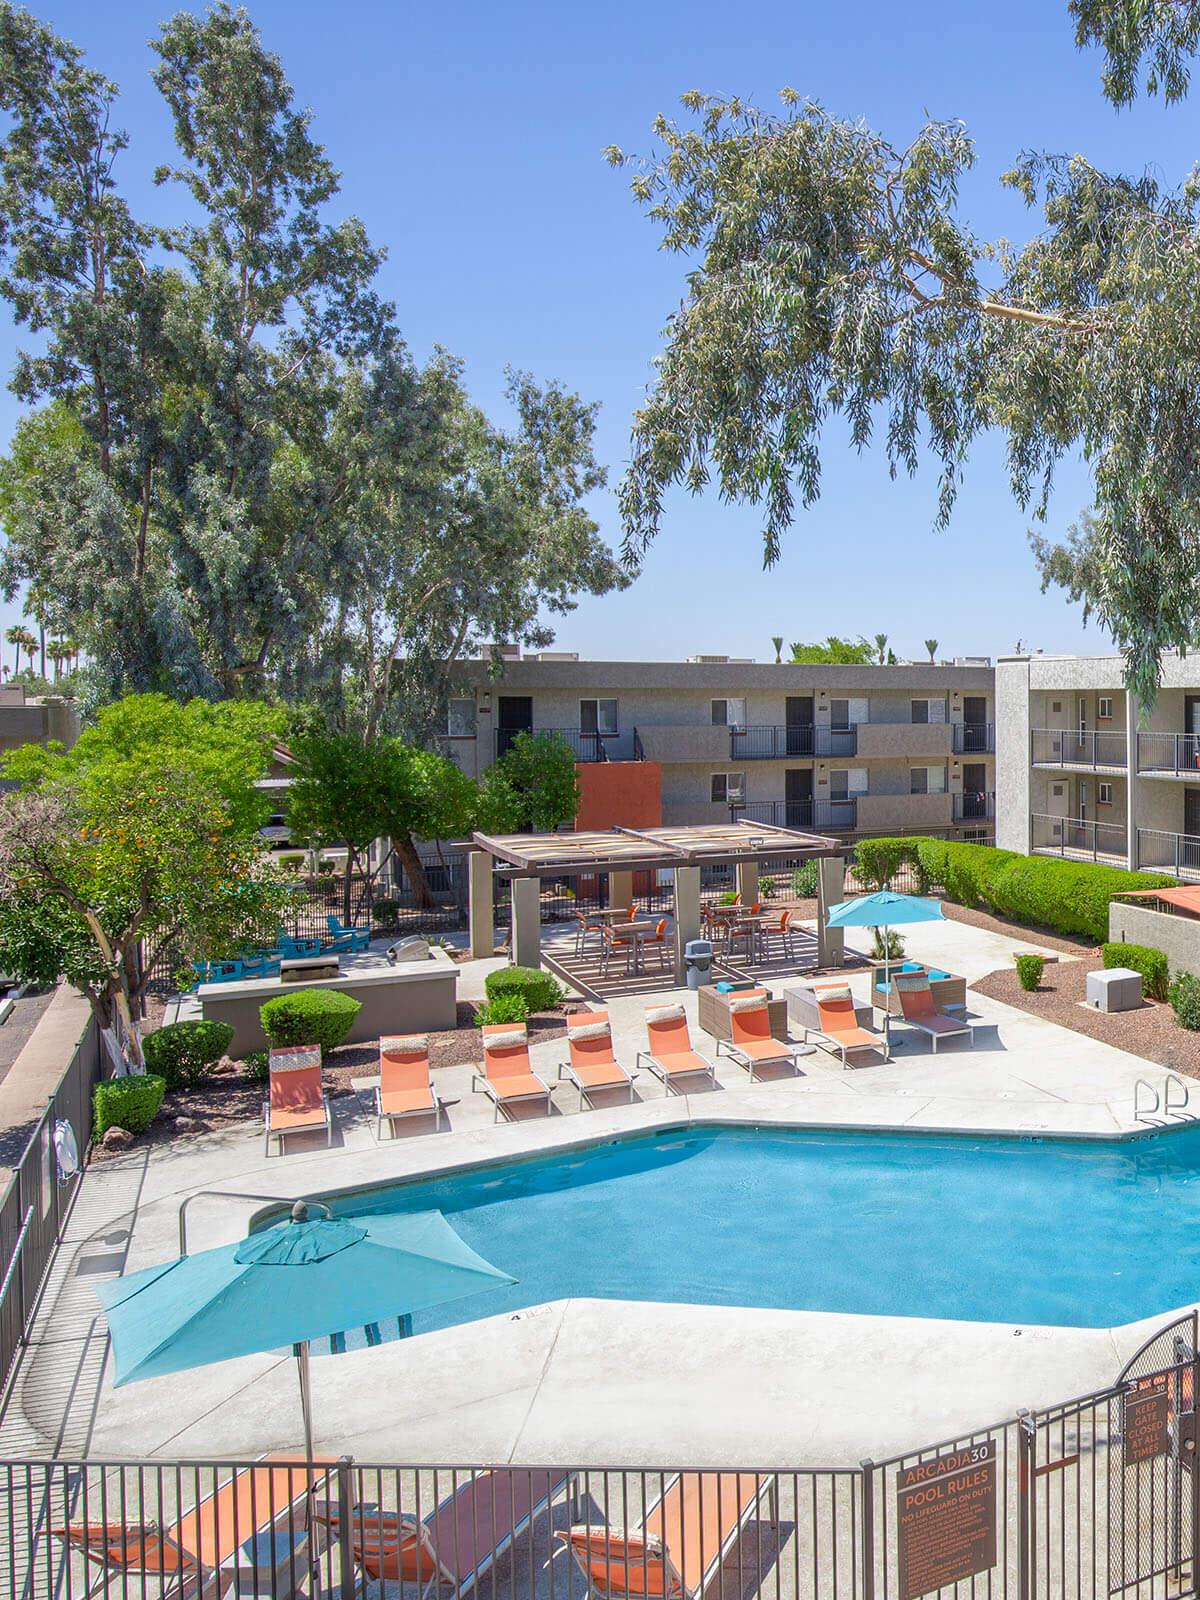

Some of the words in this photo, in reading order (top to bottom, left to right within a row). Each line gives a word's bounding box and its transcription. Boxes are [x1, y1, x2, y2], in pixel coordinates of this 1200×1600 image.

[1135, 1401, 1157, 1415] KEEP
[1134, 1412, 1158, 1427] GATE
[1128, 1420, 1164, 1439] CLOSED
[1132, 1438, 1143, 1449] AT
[1144, 1434, 1160, 1446] ALL
[1133, 1443, 1160, 1458] TIMES
[905, 1446, 989, 1485] ARCADIA30
[905, 1488, 944, 1510] POOL
[947, 1469, 989, 1495] RULES
[901, 1512, 914, 1525] NO
[915, 1498, 957, 1520] LIFEGUARD
[959, 1493, 971, 1503] ON
[972, 1485, 994, 1499] DUTY
